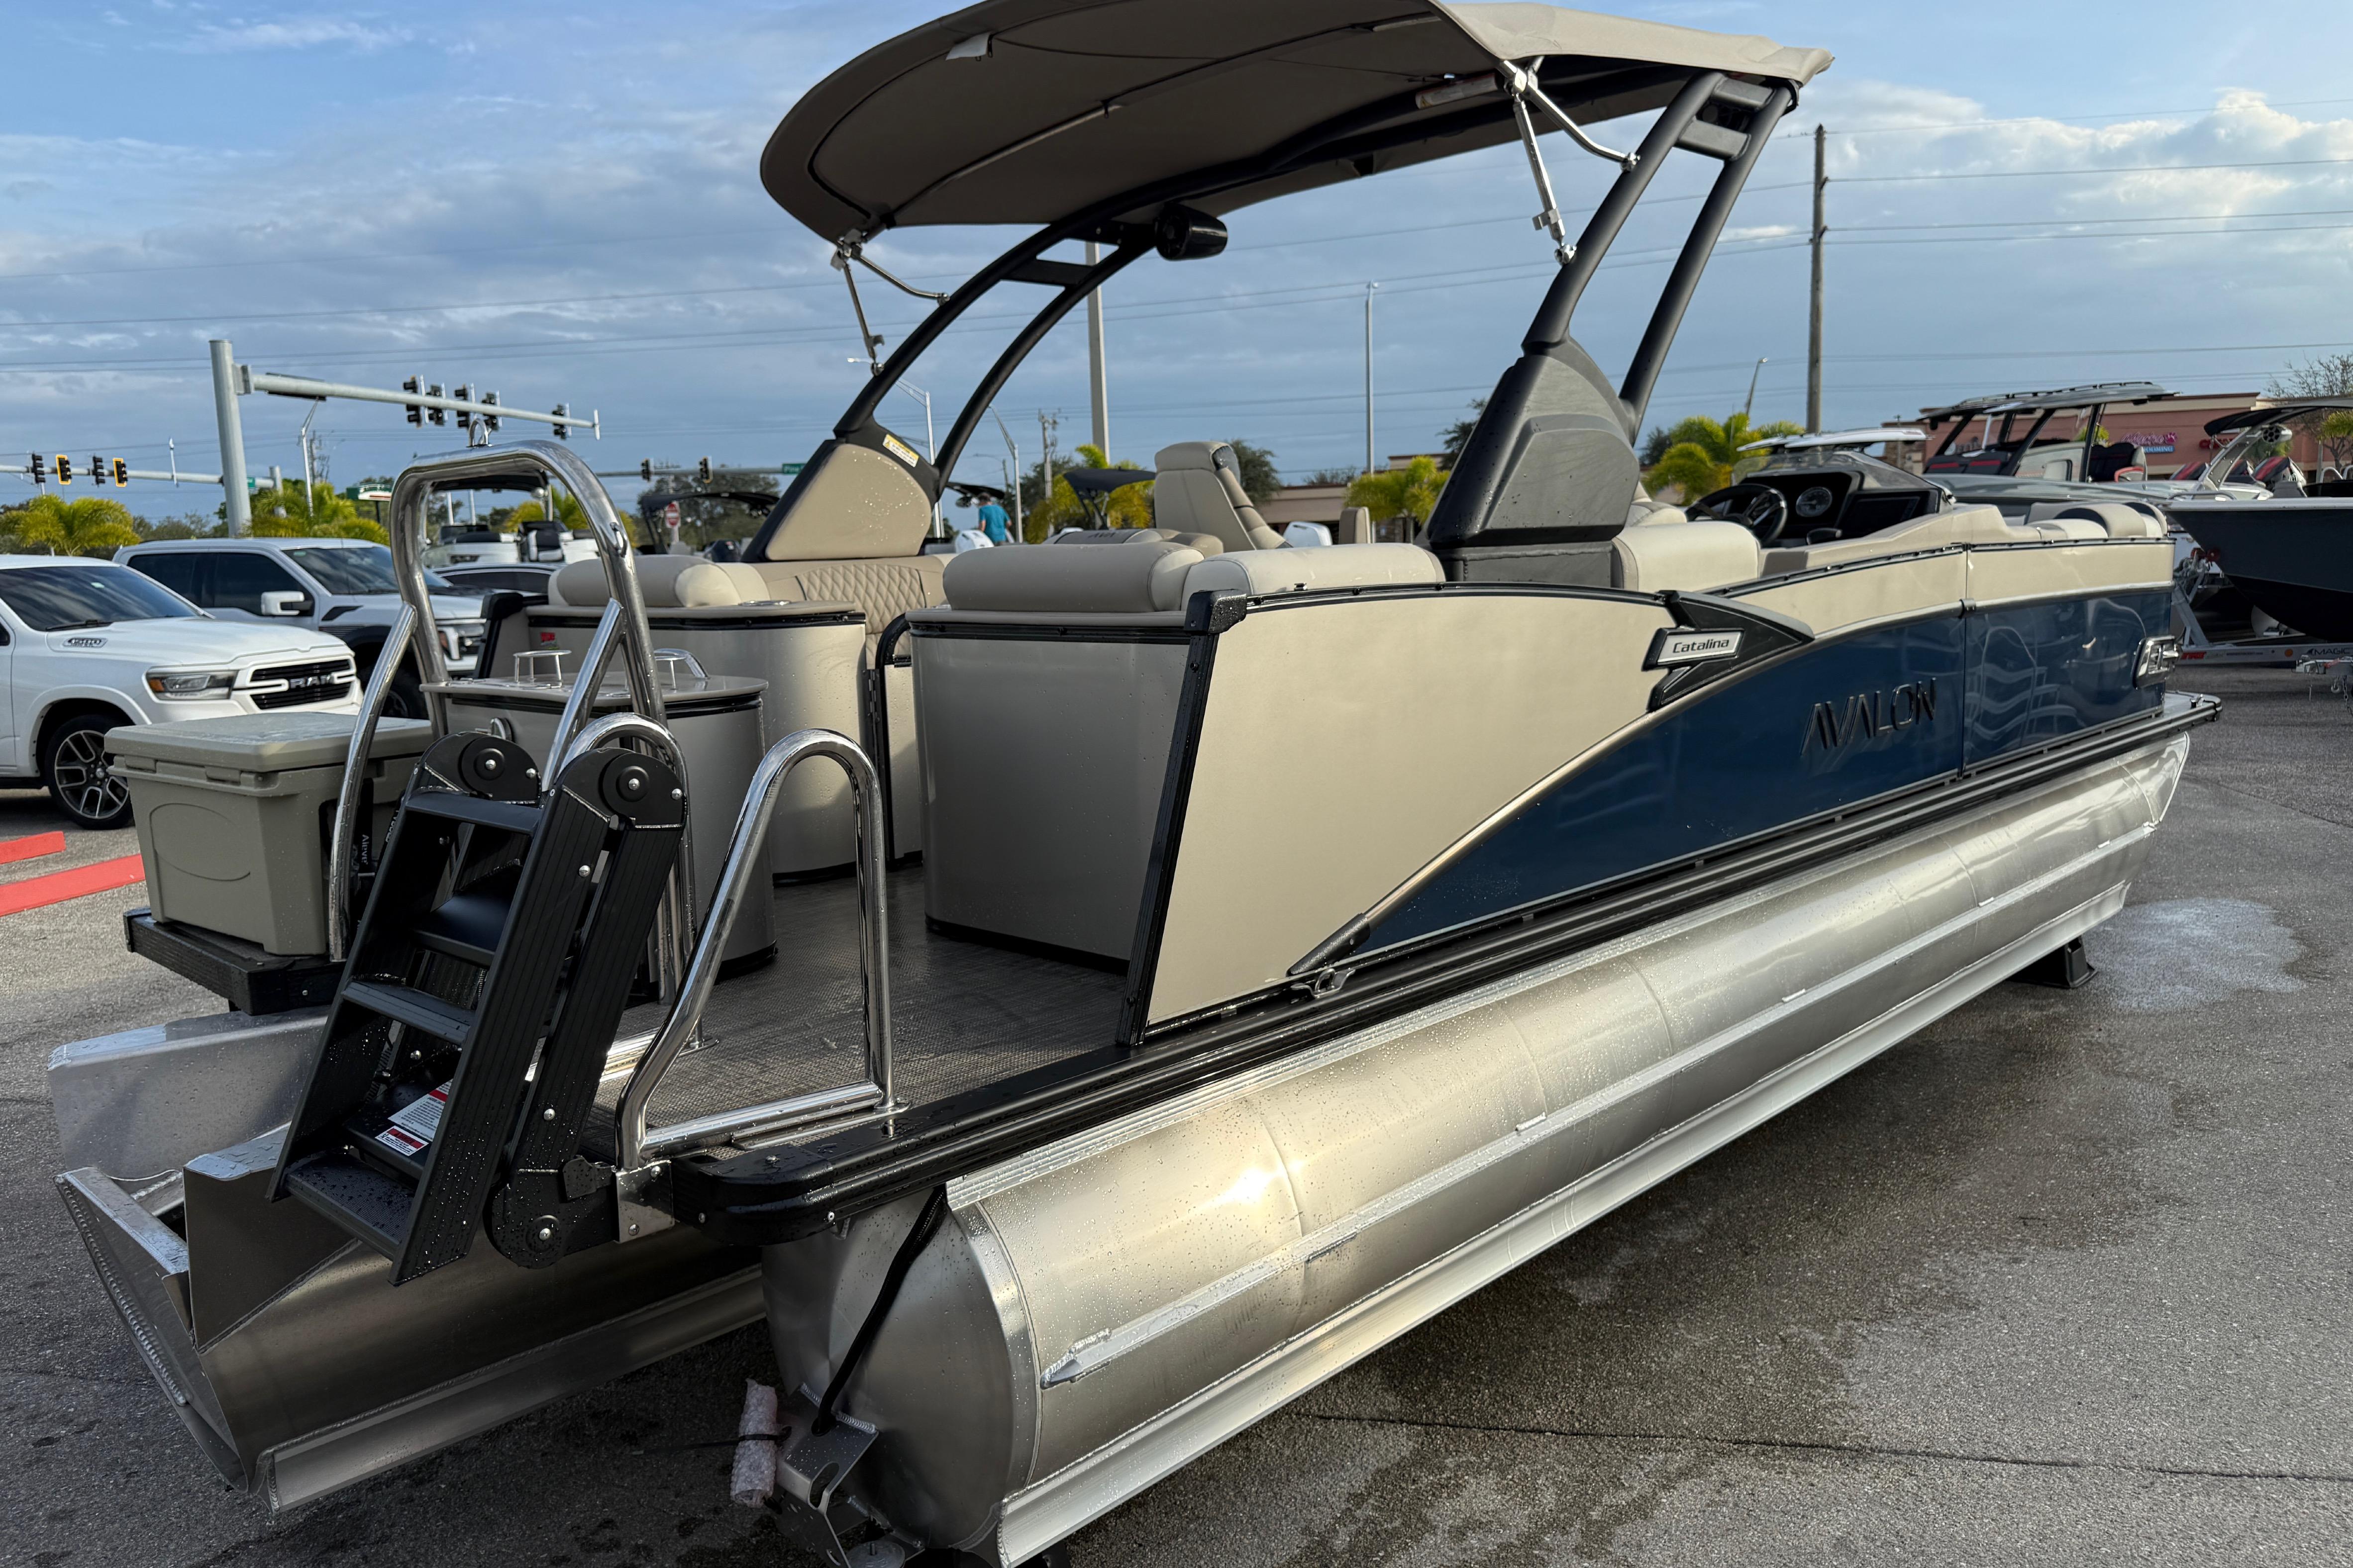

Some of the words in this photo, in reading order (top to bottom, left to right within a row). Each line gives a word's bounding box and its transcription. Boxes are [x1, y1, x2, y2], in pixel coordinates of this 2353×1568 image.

[1673, 639, 1730, 653] Catalina
[290, 675, 334, 688] RAM
[1800, 677, 1937, 756] AVALON
